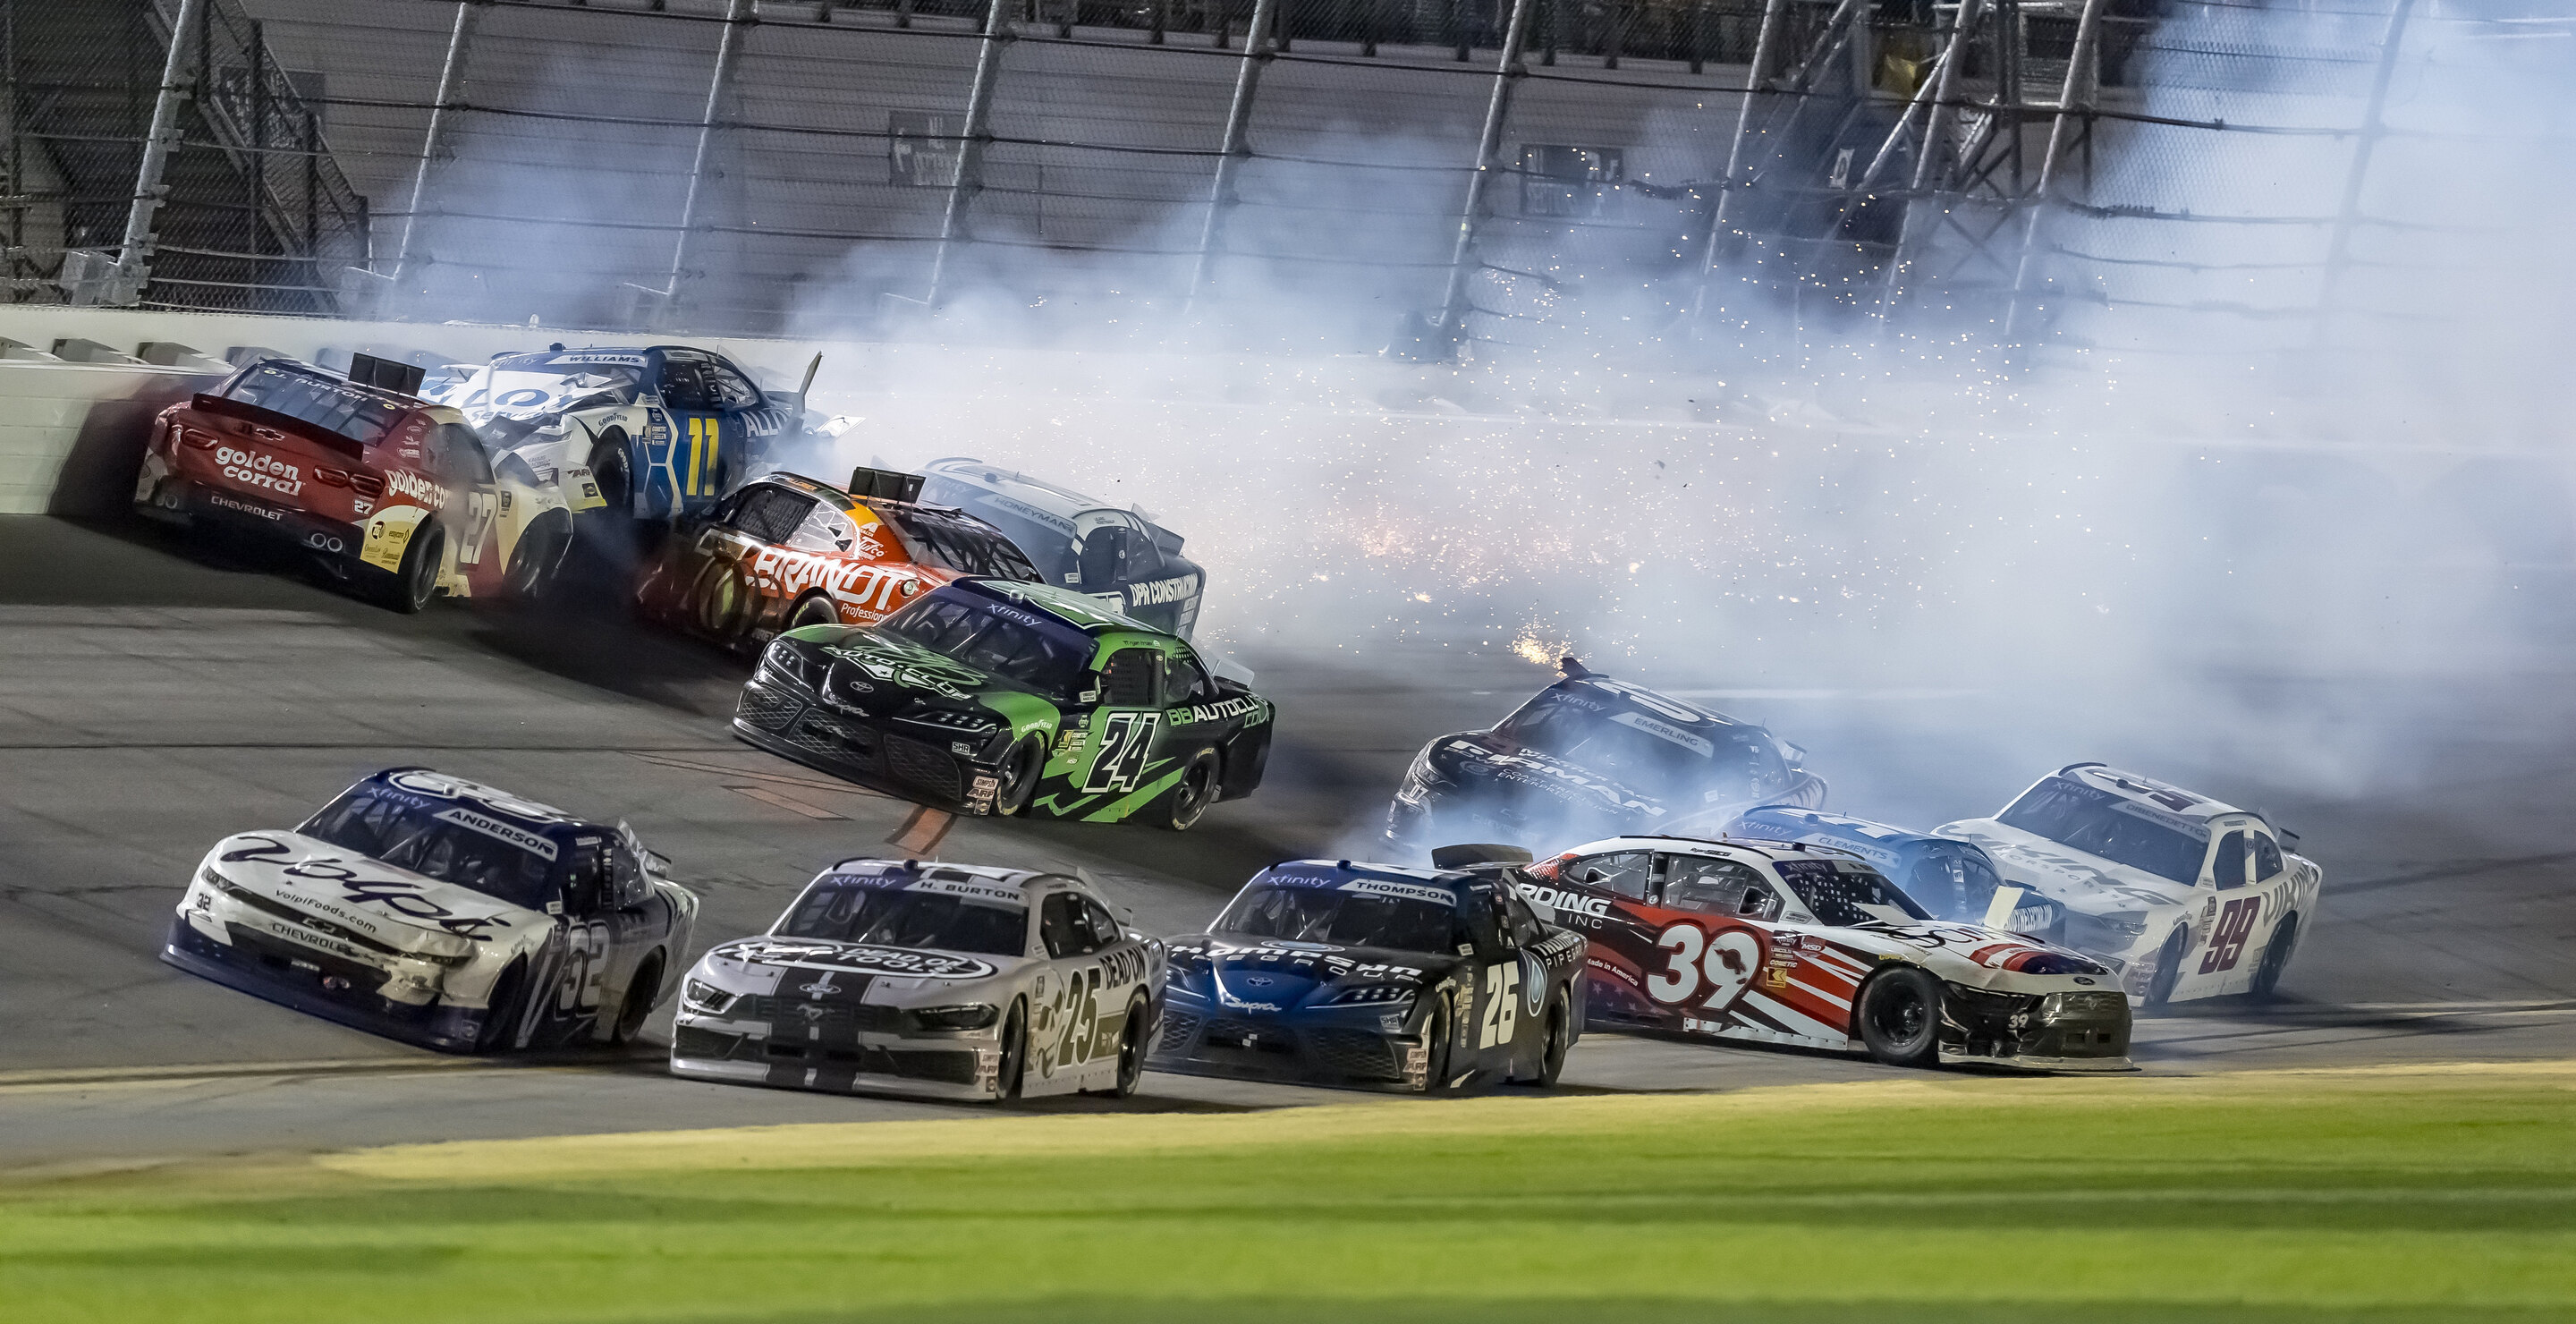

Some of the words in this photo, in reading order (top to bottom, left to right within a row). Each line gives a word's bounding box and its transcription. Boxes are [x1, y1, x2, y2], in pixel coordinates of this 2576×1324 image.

[570, 355, 640, 364] WILLIAMS
[215, 446, 299, 480] golden
[686, 417, 719, 496] 11
[223, 465, 302, 496] corral
[384, 469, 432, 505] golden
[211, 496, 284, 521] CHEVROLET
[353, 500, 374, 515] 27
[995, 497, 1067, 530] HONEYMAN
[459, 491, 498, 564] 27
[746, 546, 901, 611] BRANDT
[1129, 582, 1151, 607] DPR
[987, 604, 1043, 627] xfinity
[1550, 692, 1606, 712] xfinity
[1021, 719, 1053, 733] GOODYEAR
[1633, 717, 1699, 746] EMERLING
[1081, 712, 1162, 794] 24
[366, 787, 431, 809] xfinity
[2054, 781, 2106, 801] xfinity
[449, 811, 552, 854] ANDERSON
[1737, 820, 1792, 836] xfinity
[1818, 836, 1889, 860] CLEMENTS
[831, 875, 896, 888] xfinity
[920, 881, 937, 890] H.
[945, 883, 1020, 901] BURTON
[1267, 874, 1332, 888] xfinity
[1356, 881, 1451, 902] THOMPSON
[195, 892, 212, 912] 32
[275, 889, 377, 934] VolpiFoods.com
[1568, 912, 1604, 929] INC
[271, 921, 356, 956] CHEVROLE
[2198, 895, 2262, 975] 99
[844, 948, 921, 963] DEAD
[1801, 943, 1822, 952] MSD
[1166, 945, 1423, 977] HOMPSON
[1647, 923, 1760, 1010] 39
[1603, 963, 1611, 971] in
[1611, 965, 1639, 987] America
[1225, 995, 1282, 1014] Supra
[1479, 960, 1520, 1049] 26
[1055, 968, 1101, 1068] 25
[2008, 1014, 2029, 1030] 39
